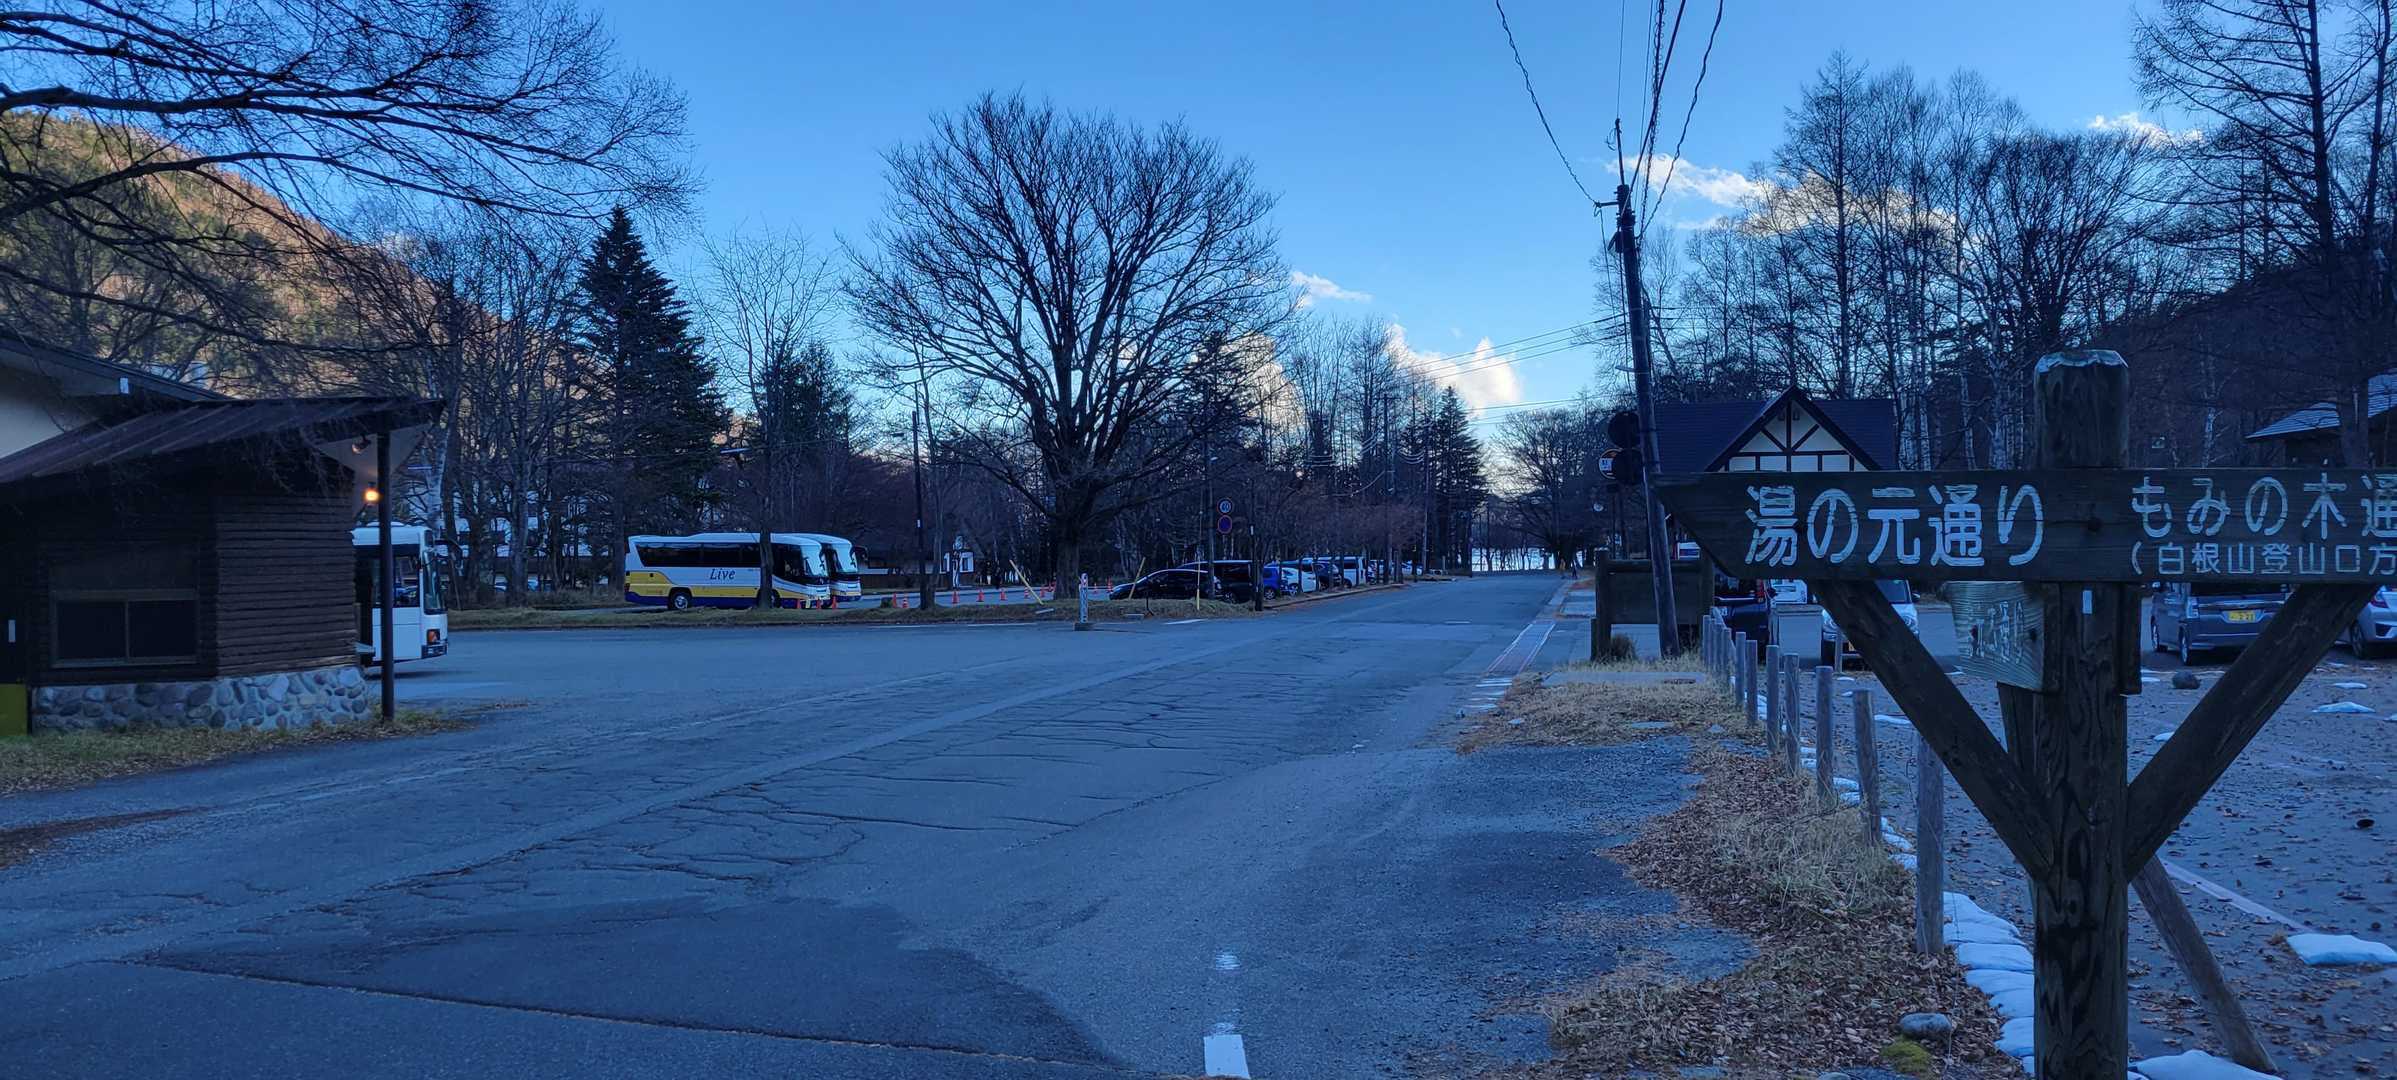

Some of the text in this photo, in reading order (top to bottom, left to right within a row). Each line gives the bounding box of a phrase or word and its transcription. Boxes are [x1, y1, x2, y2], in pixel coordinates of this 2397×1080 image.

[1744, 483, 2044, 567] 湯の元通り
[710, 568, 736, 580] Live
